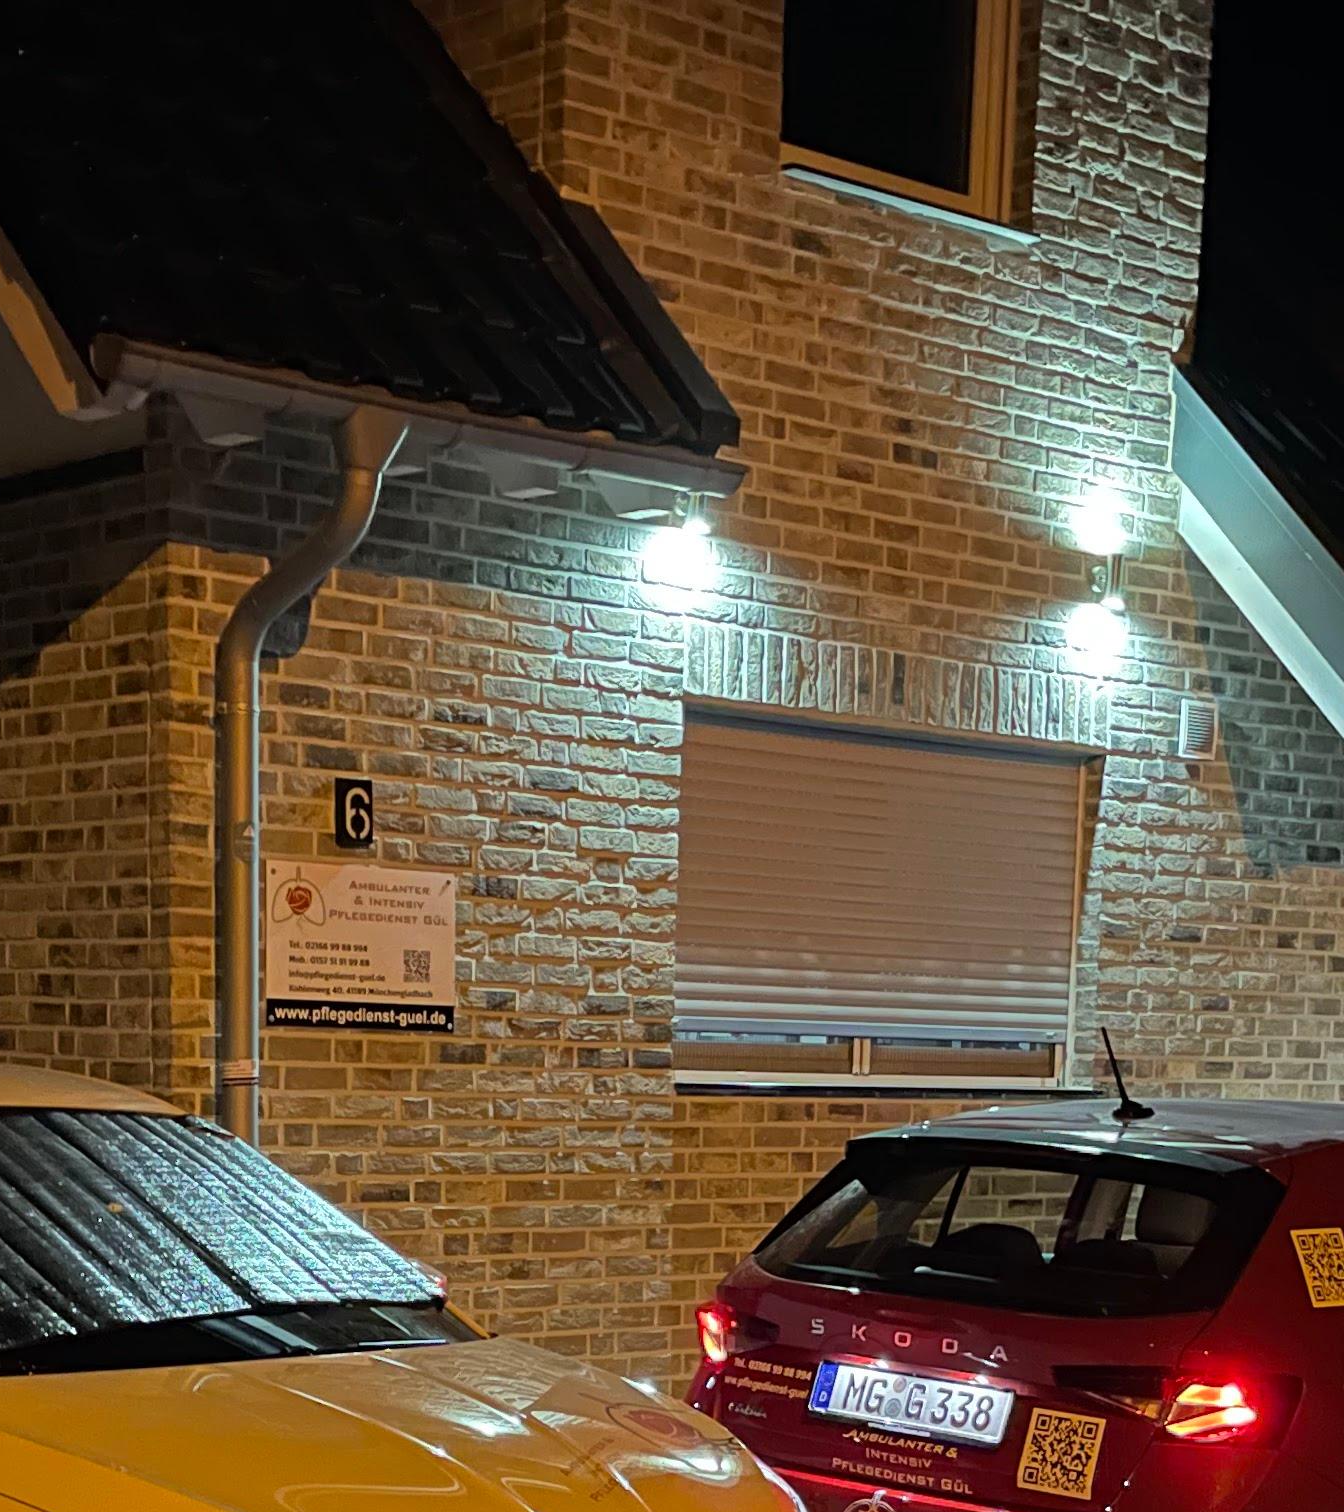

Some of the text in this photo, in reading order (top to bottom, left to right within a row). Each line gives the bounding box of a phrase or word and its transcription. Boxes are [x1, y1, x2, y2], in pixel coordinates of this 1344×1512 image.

[345, 787, 370, 840] 6
[348, 880, 430, 895] AMBULANTER
[354, 896, 425, 909] & INTENSIV
[328, 909, 449, 926] PFLEGEDIENST GÜL
[274, 1006, 446, 1026] www.pflegedienst-guel.de
[818, 1372, 994, 1432] D MG G 338
[844, 1428, 958, 1459] AMBULANTER &
[865, 1447, 932, 1468] INTENSIV
[832, 1457, 973, 1495] PFLEGEDIENST GÜL
